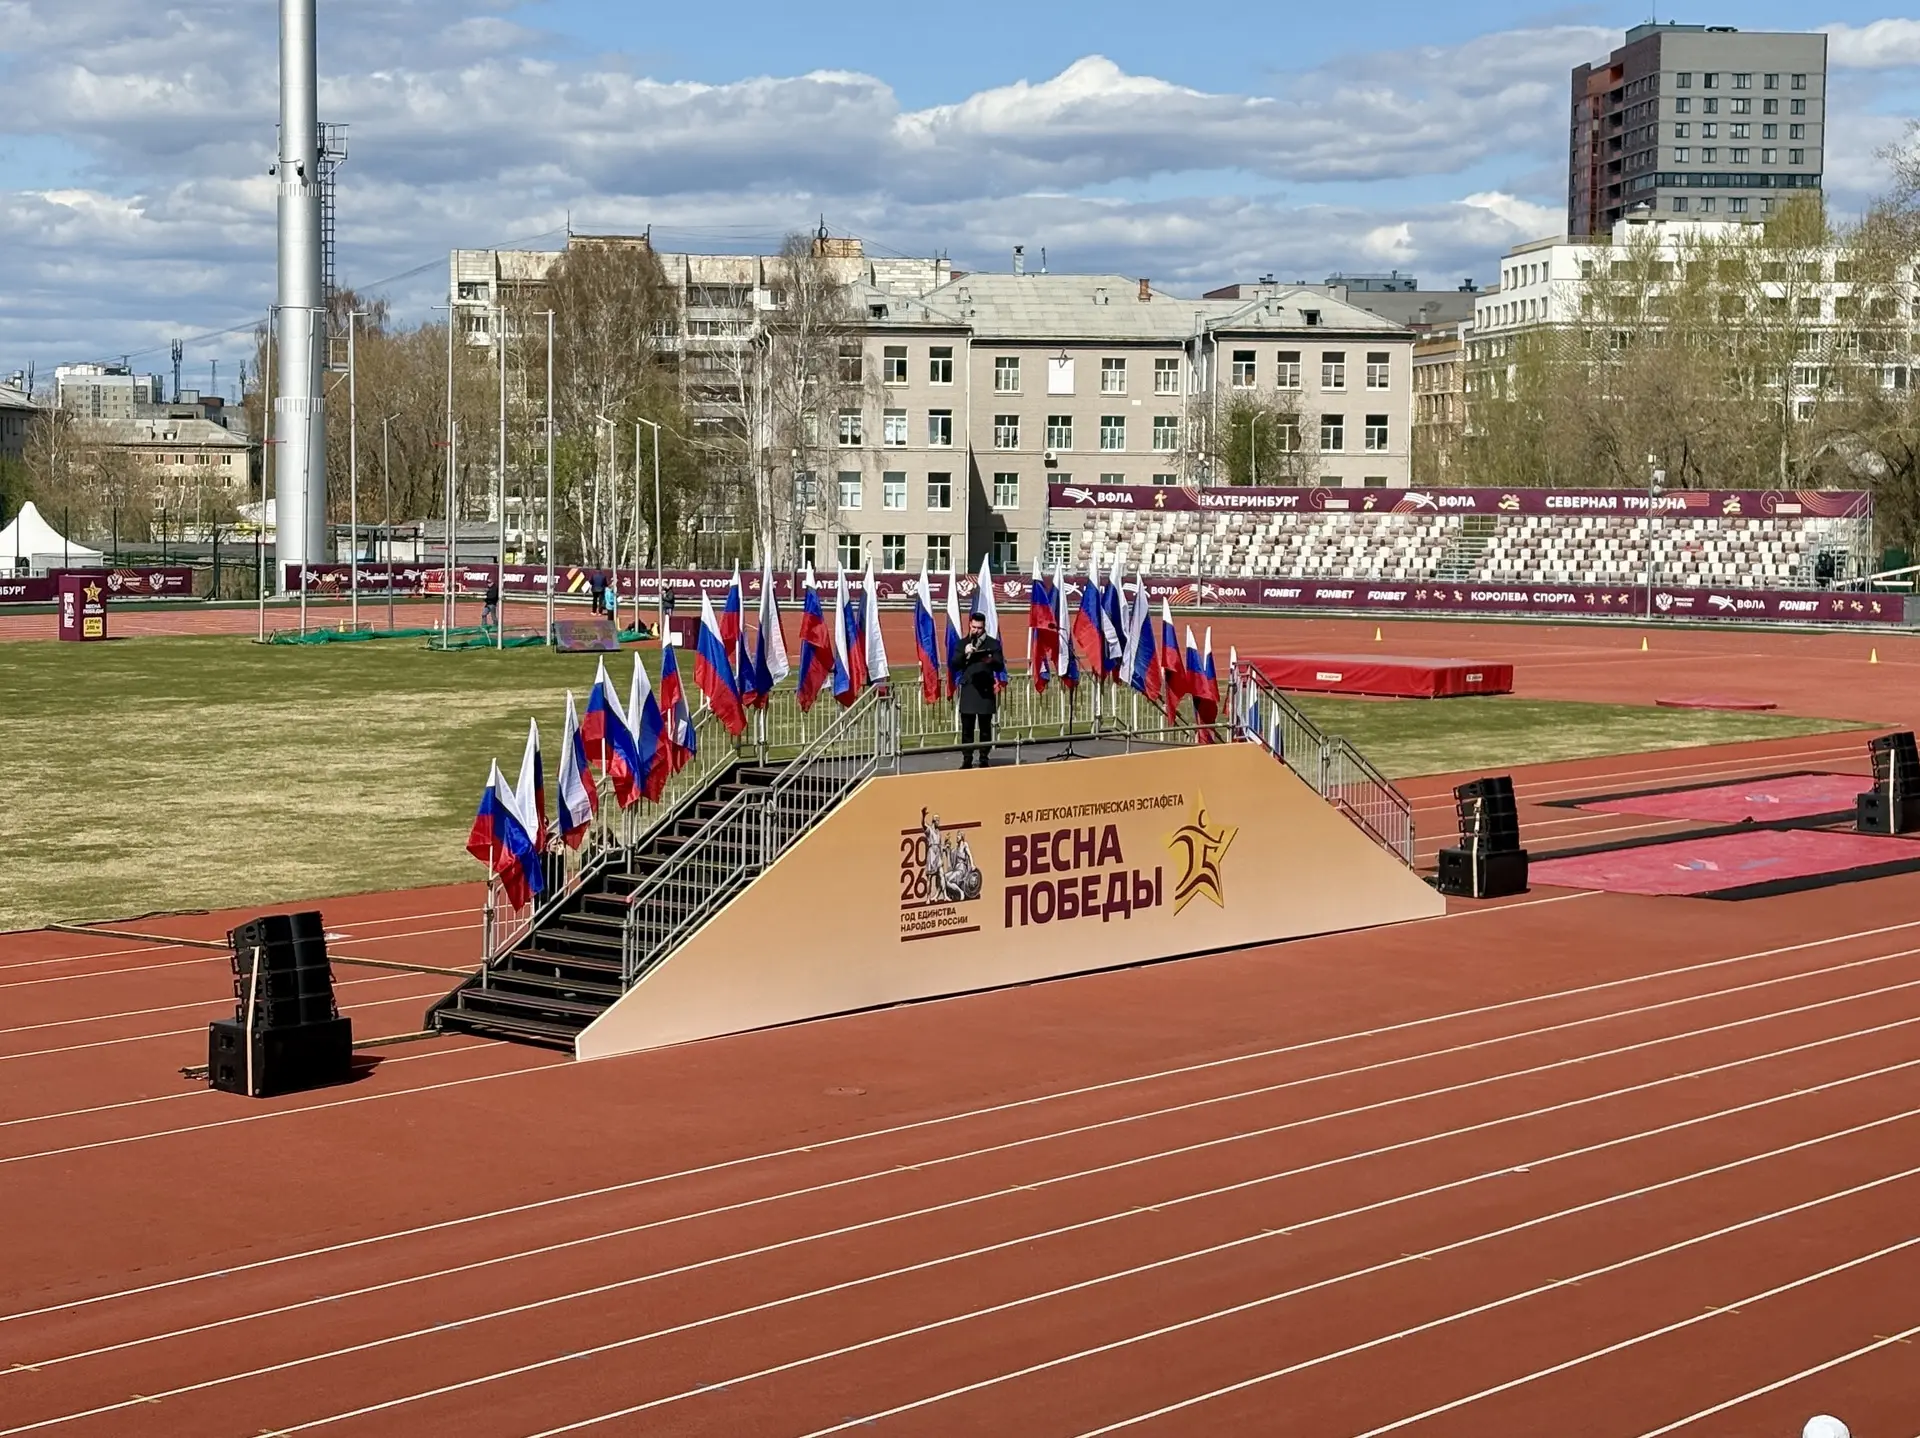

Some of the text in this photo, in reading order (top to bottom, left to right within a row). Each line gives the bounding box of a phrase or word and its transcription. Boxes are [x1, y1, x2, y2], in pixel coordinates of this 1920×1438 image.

[1098, 492, 1133, 504] ВФЛА
[1198, 495, 1299, 508] ЕКАТЕРИНБУРГ
[1439, 495, 1476, 507] ВФЛА
[1546, 496, 1687, 509] СЕВЕРНАЯ ТРИБУНА
[463, 572, 489, 581] FONBET
[502, 573, 525, 582] ONBET
[533, 574, 560, 584] FONT
[1151, 585, 1179, 595] ВФЛА
[1218, 587, 1246, 597] ВФЛА
[1264, 588, 1302, 598] FONBET
[1316, 589, 1354, 599] FONBET
[1367, 590, 1407, 600] FONBET
[1471, 591, 1576, 603] КОРОЛЕВА СПОРТА
[1737, 599, 1766, 609] ВФЛА
[1778, 600, 1819, 611] FONBET
[1004, 794, 1184, 825] 87-АЯ ЛЕГКОАТЛЕТИЧЕСКАЯ ЭСТАФЕТА
[900, 836, 928, 869] 20
[1004, 823, 1124, 878] ВЕСНА
[900, 868, 928, 901] 26
[1004, 866, 1163, 929] ПОБЕДЫ
[901, 907, 956, 922] ГОД ЕДИНСТВА
[901, 916, 968, 932] НАРОДОВ РОССИИ
